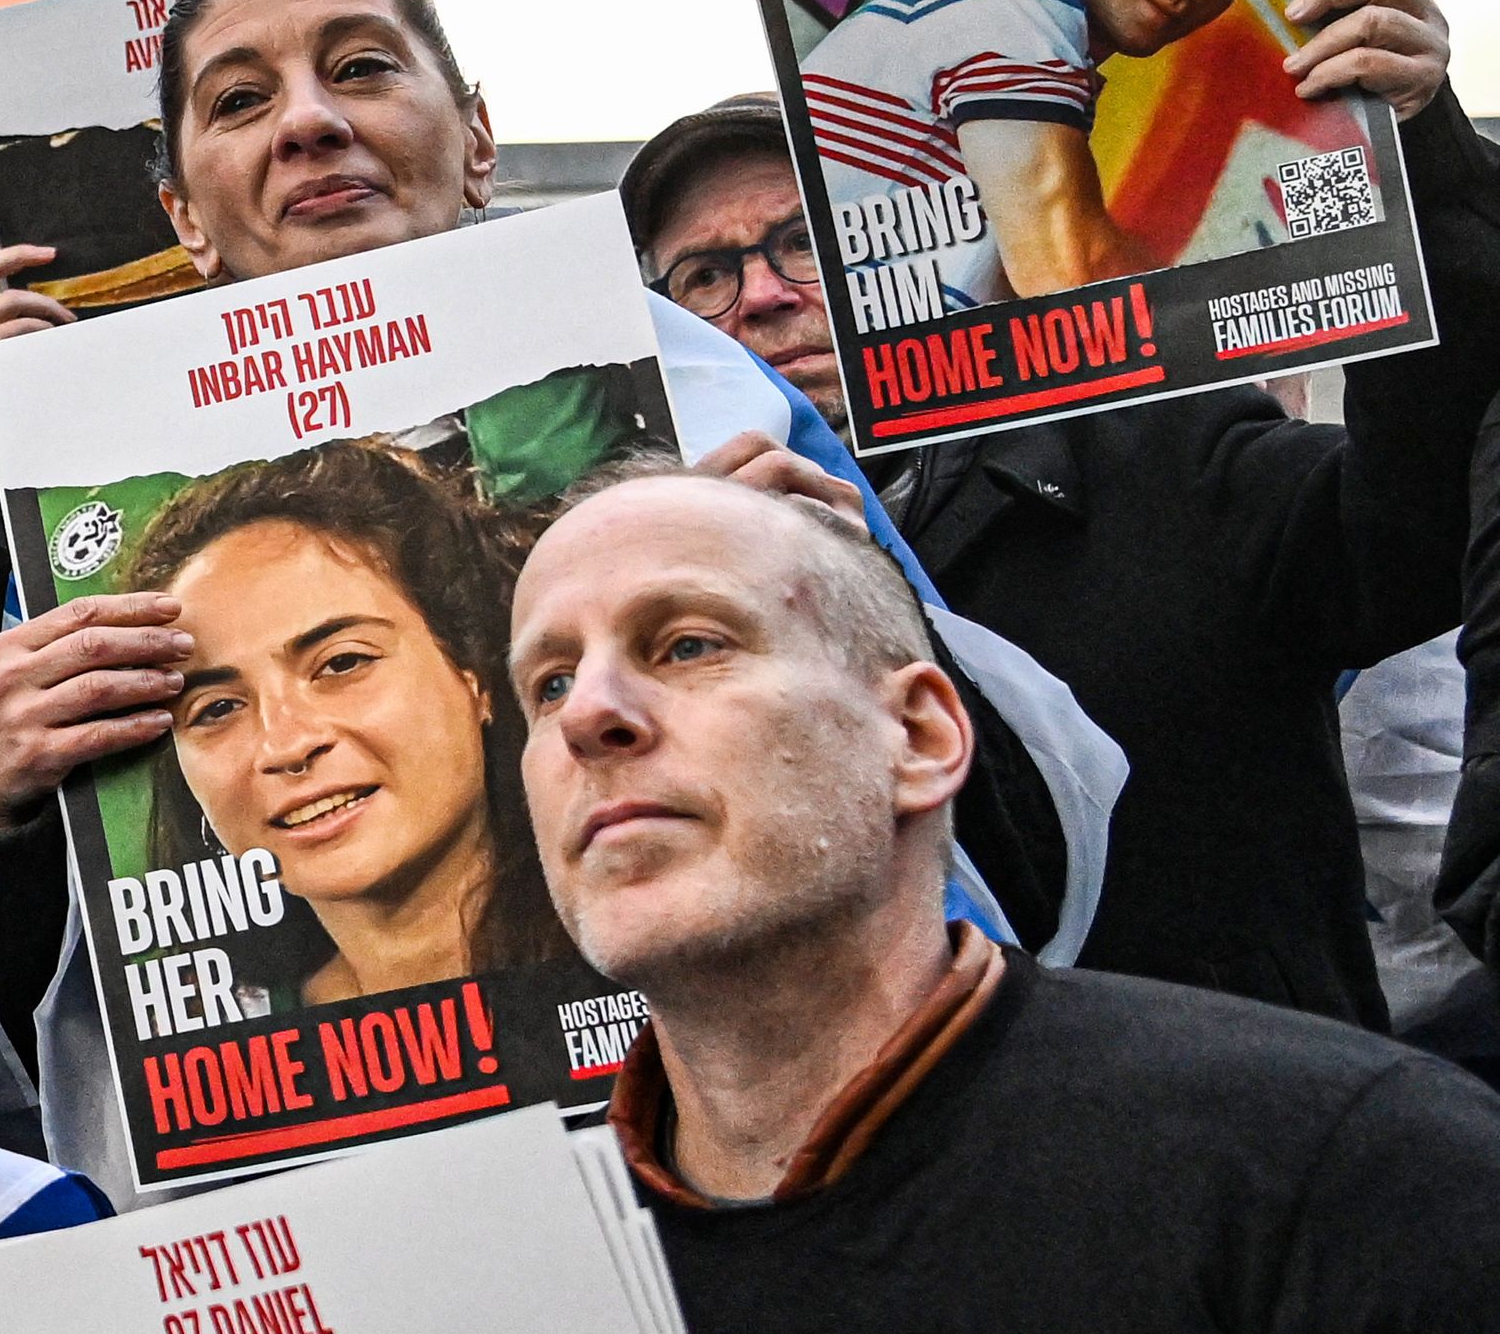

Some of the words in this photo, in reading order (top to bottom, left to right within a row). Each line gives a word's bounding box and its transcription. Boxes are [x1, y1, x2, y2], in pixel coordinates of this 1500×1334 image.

[835, 176, 983, 265] BRING
[221, 299, 294, 355] הימן
[297, 278, 376, 330] ענבר
[845, 258, 947, 335] HIM
[1208, 285, 1289, 321] HOSTAGES
[1291, 278, 1323, 305] AND
[1323, 262, 1396, 298] MISSING
[1212, 304, 1316, 352] FAMILIES
[1318, 285, 1402, 331] FORUM
[188, 350, 288, 408] INBAR
[291, 314, 432, 383] HAYMAN
[861, 324, 1003, 410] HOME
[1009, 282, 1157, 382] NOW!
[287, 381, 351, 439] (27)
[107, 848, 285, 956] BRING
[124, 948, 243, 1042] HER
[142, 1028, 314, 1135] HOME
[317, 981, 498, 1103] NOW!
[138, 1230, 240, 1303] דניאל
[234, 1214, 302, 1280] עוז
